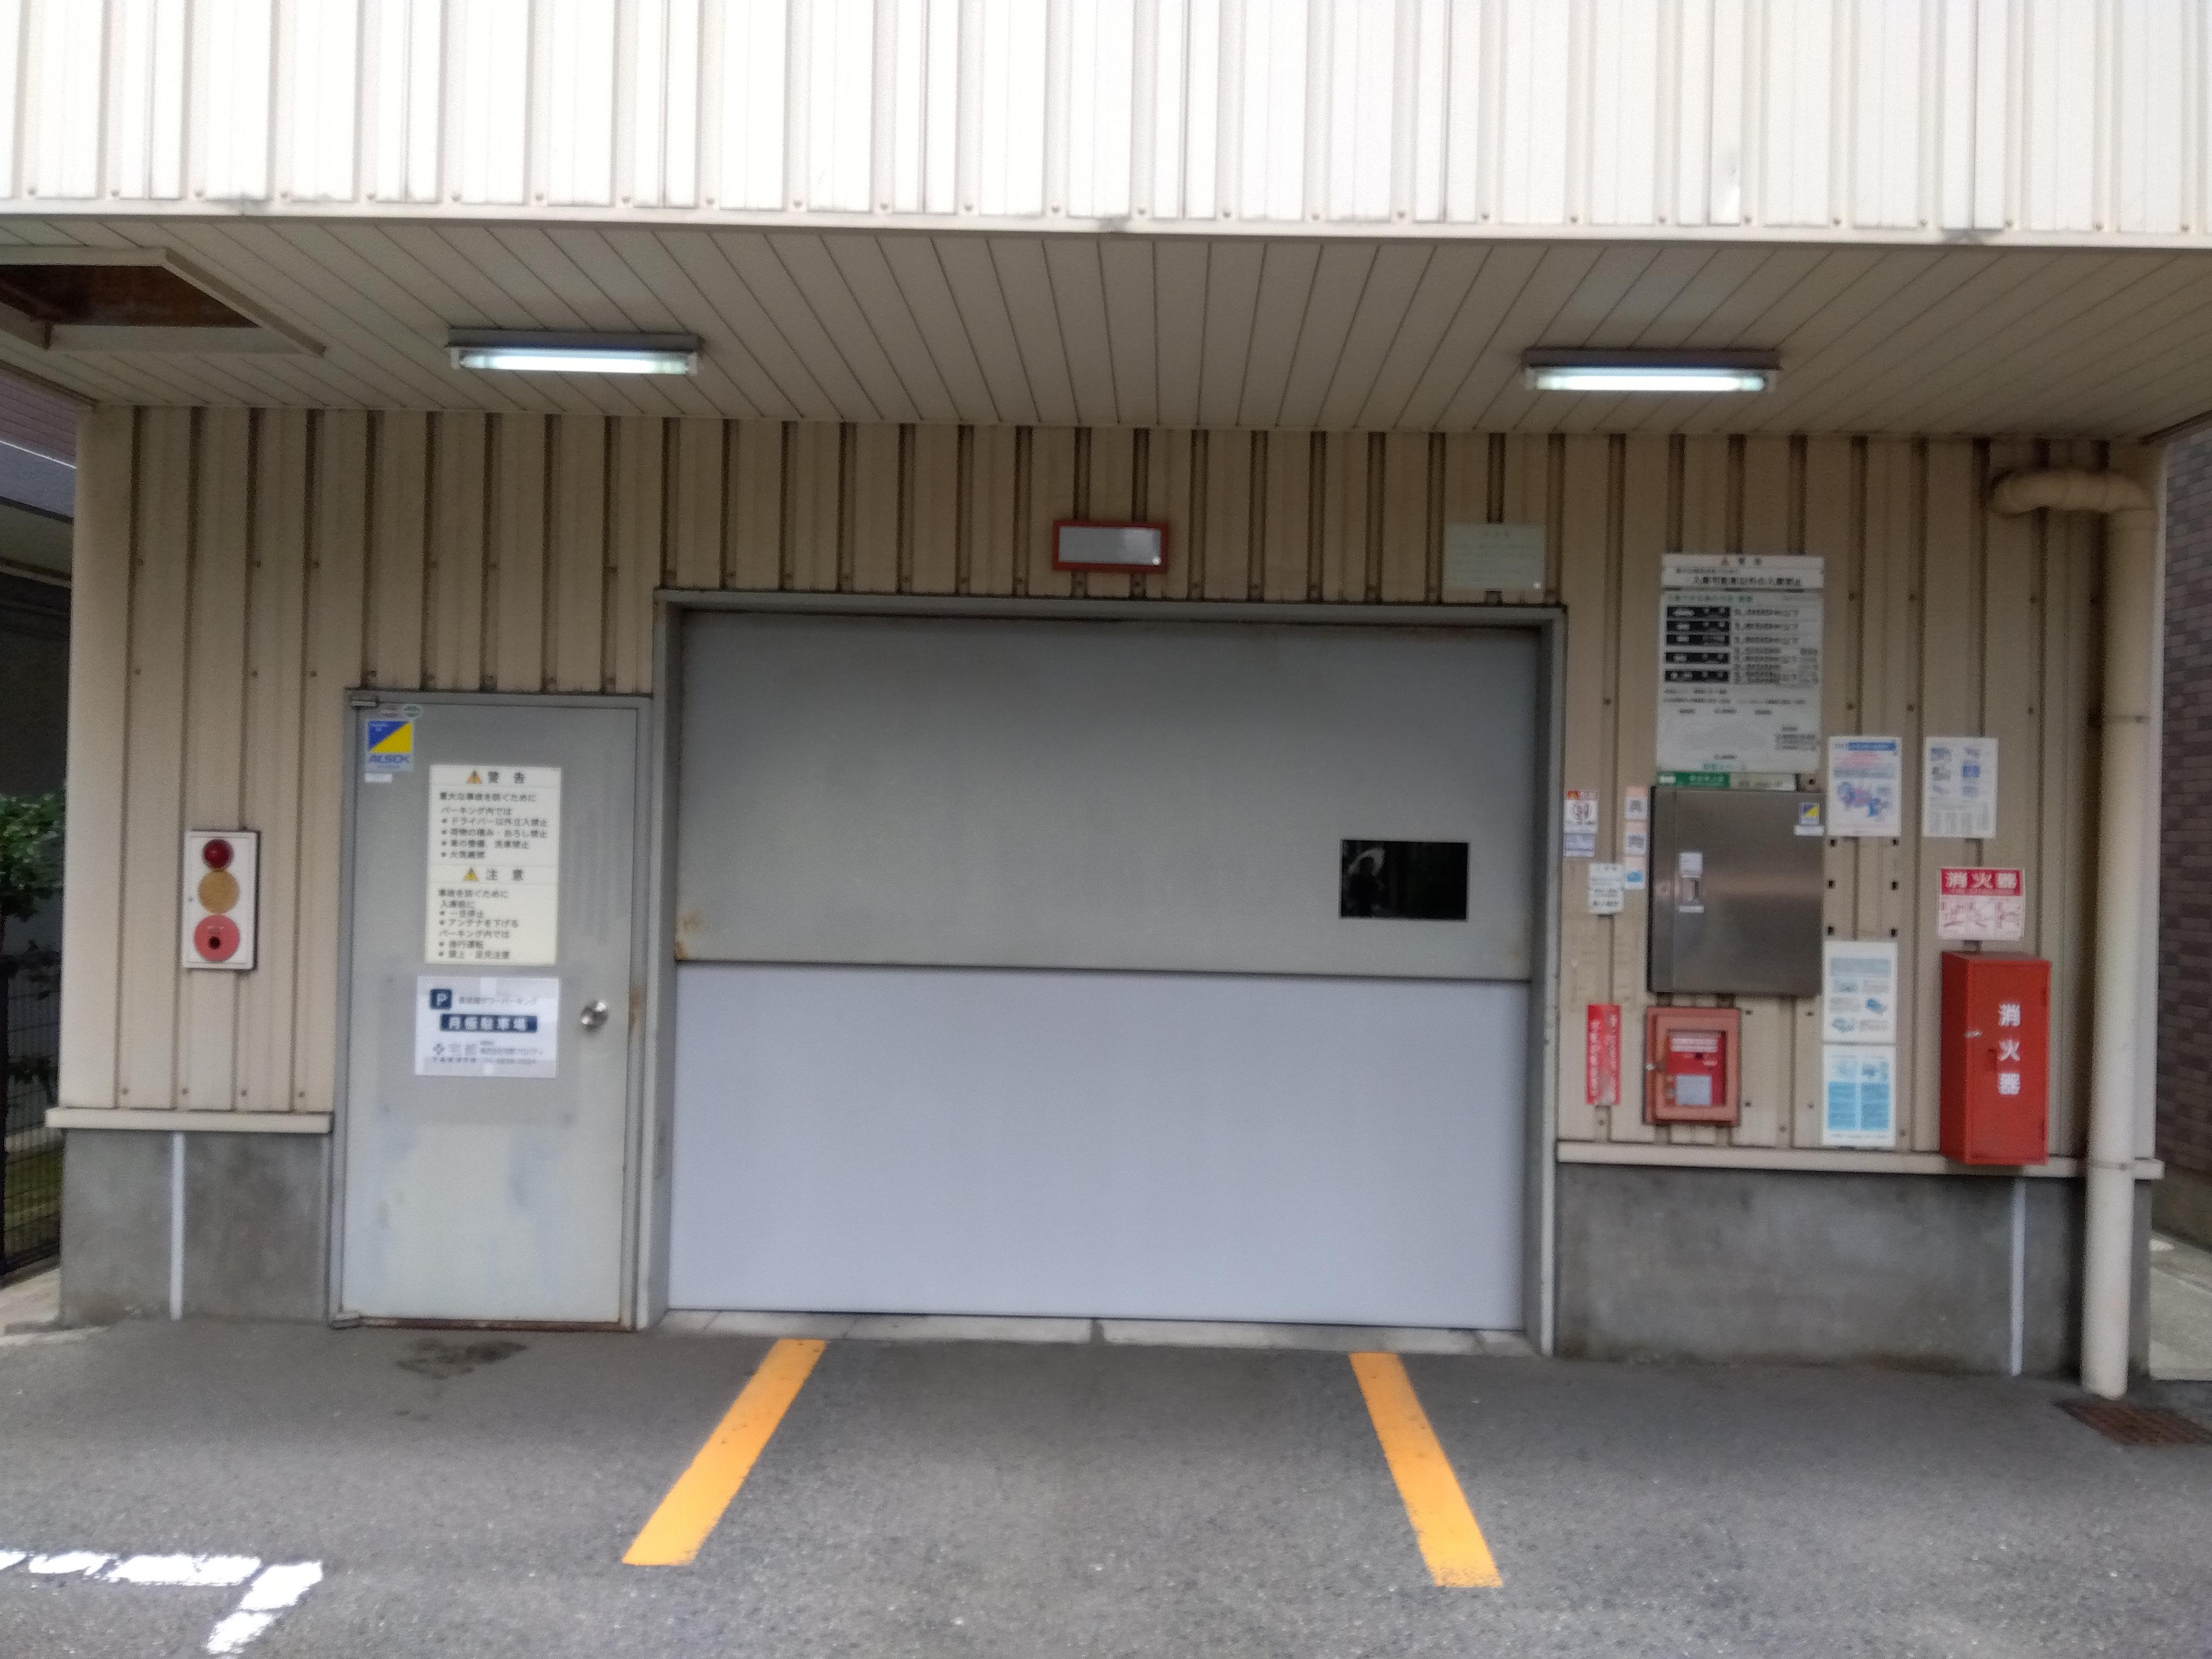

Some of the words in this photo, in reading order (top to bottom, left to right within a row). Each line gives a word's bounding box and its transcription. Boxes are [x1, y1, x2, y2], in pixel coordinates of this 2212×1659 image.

[487, 771, 526, 784] 警告
[439, 791, 537, 802] 重大な事故を防ぐために
[441, 806, 512, 816] パーキング内では
[451, 817, 548, 828] ドライバー以外立入禁止
[486, 869, 524, 881] 注意
[1945, 871, 2017, 889] 消火器
[438, 889, 509, 899] 事故を防ぐために
[448, 919, 519, 929] アンテナを下げる
[438, 930, 510, 939] パーキング内では
[436, 993, 448, 1006] P
[448, 1016, 527, 1032] 月極駐車場
[1998, 1003, 2021, 1095] 消火器
